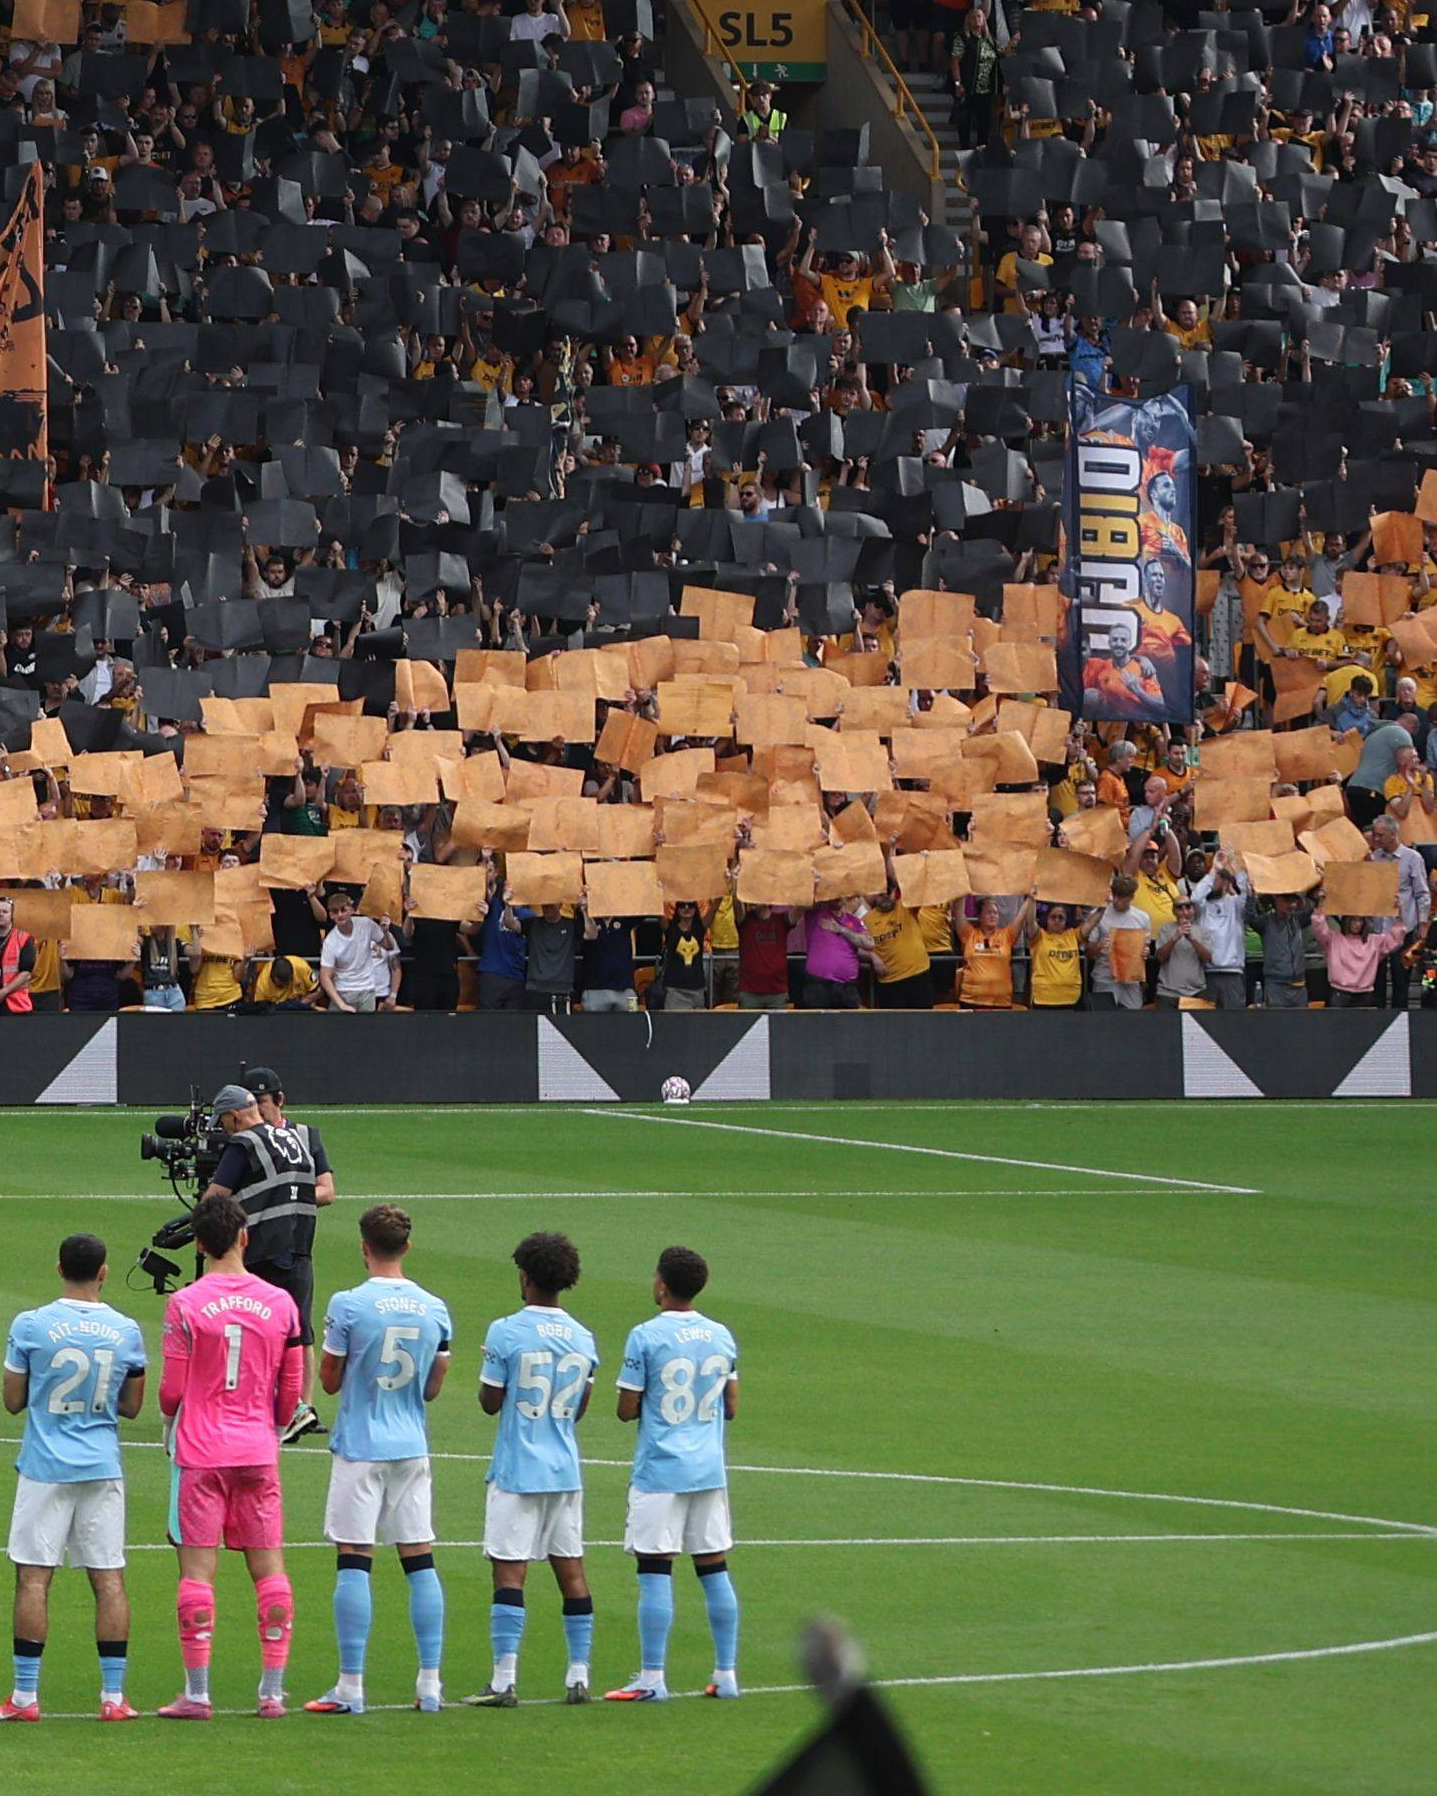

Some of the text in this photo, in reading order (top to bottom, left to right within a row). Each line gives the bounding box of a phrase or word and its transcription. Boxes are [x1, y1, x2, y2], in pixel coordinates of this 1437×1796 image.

[718, 12, 794, 48] SL5
[200, 1295, 274, 1321] TRAFFORD
[374, 1297, 428, 1317] STONES
[536, 1323, 574, 1340] BOBB
[224, 1324, 243, 1391] 1
[375, 1326, 420, 1392] 5
[674, 1328, 713, 1345] LEWIS
[48, 1347, 115, 1414] 21
[516, 1351, 592, 1420] 52
[659, 1354, 730, 1425] 82
